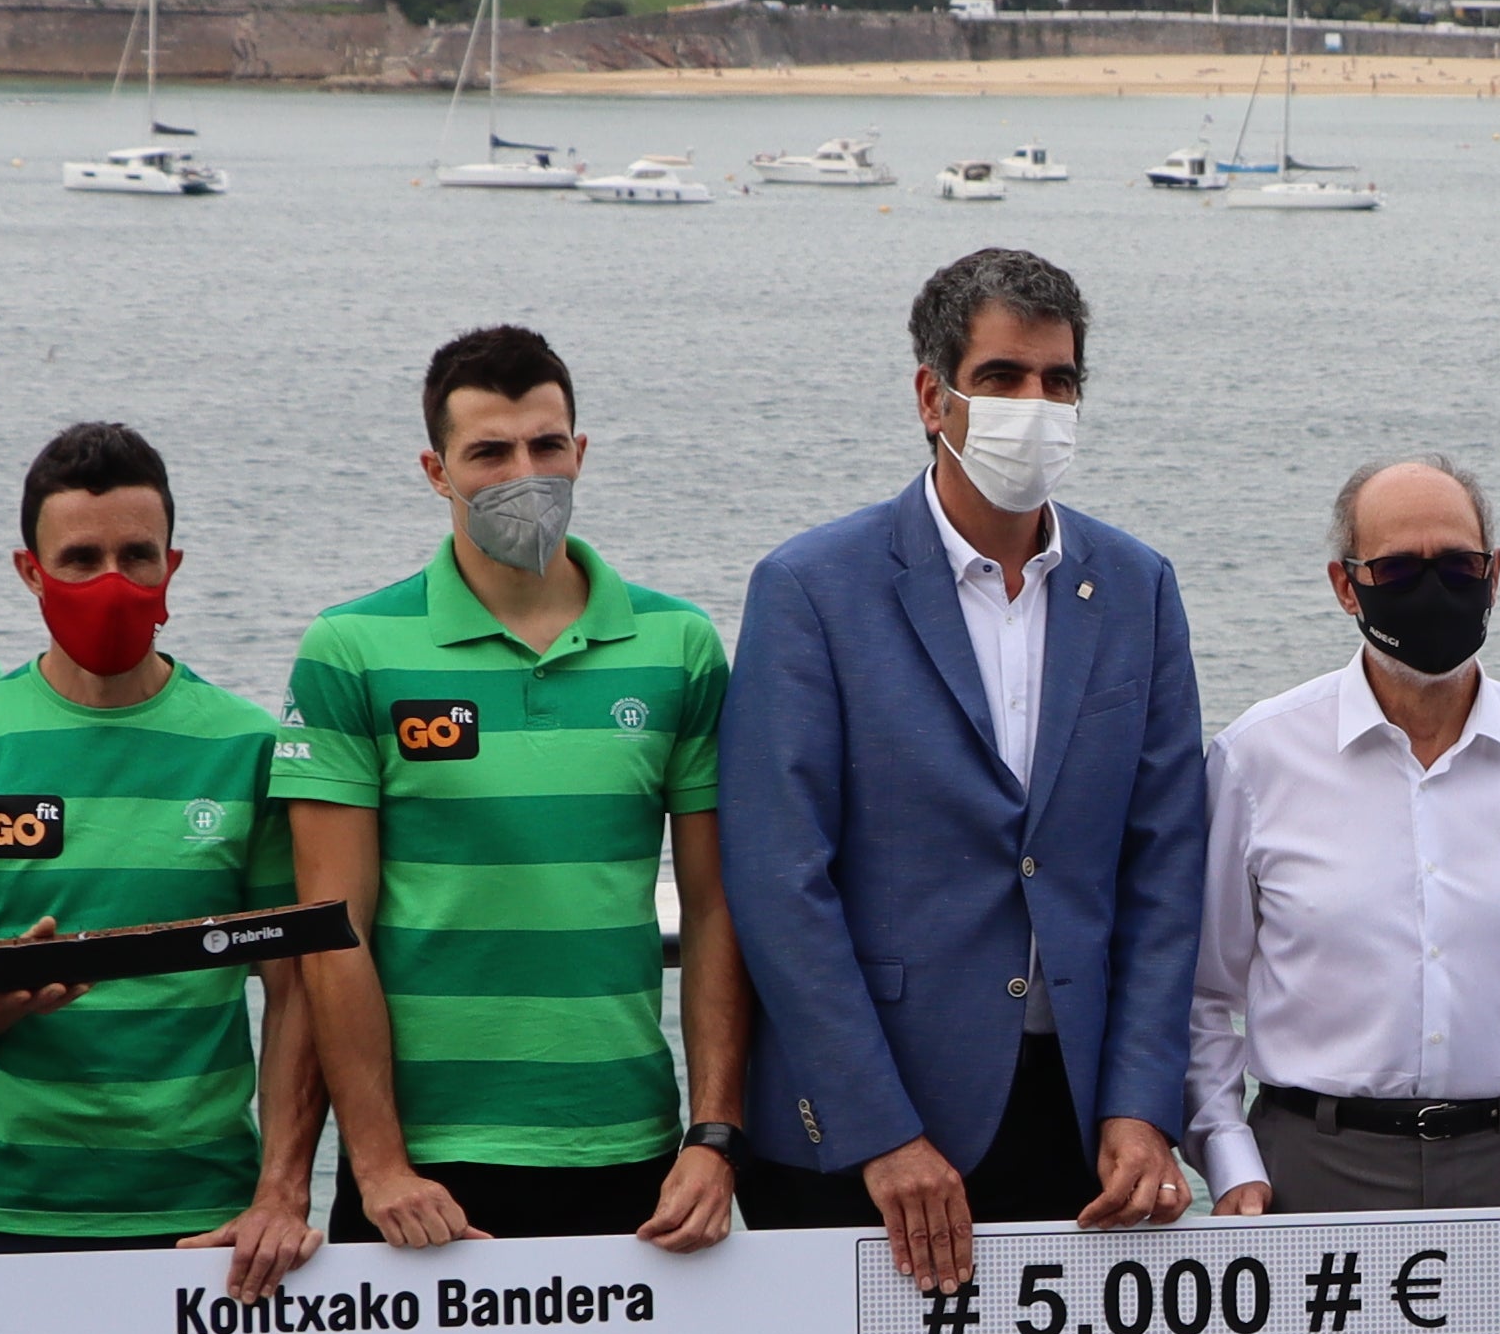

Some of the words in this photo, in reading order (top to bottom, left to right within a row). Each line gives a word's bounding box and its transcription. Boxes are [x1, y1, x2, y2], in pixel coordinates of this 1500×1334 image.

[401, 716, 461, 749] GO
[450, 706, 474, 724] fit
[35, 802, 60, 820] fit
[231, 926, 284, 945] Fabrika
[437, 1275, 654, 1328] Bandera
[1304, 1251, 1362, 1334] #
[1389, 1249, 1448, 1329] €
